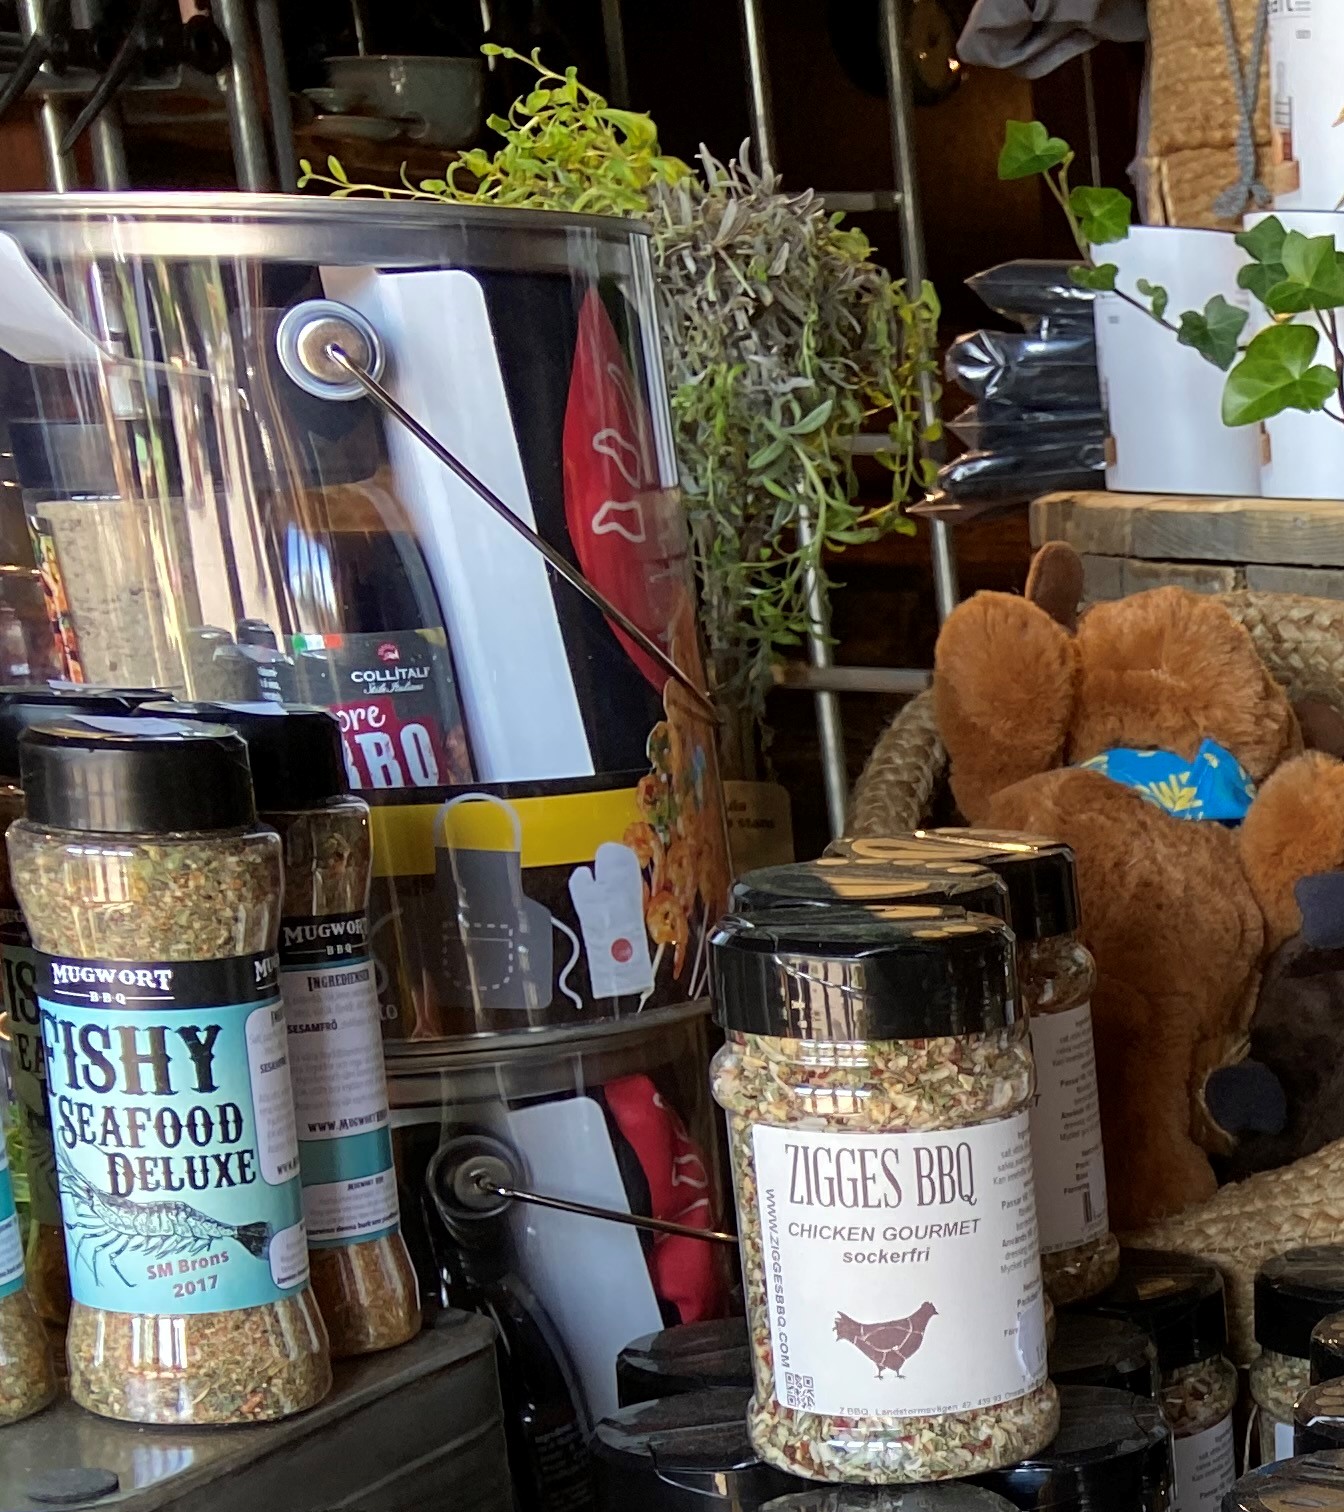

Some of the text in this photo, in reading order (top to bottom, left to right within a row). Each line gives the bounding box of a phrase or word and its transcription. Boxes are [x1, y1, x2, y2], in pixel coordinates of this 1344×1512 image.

[51, 962, 174, 991] MUGWORT
[40, 1010, 224, 1097] FISHY
[57, 1095, 246, 1151] SEAFOOD
[106, 1147, 257, 1199] DELUXE
[784, 1141, 978, 1209] ZIGGES BBQ
[787, 1217, 982, 1243] CHICKEN GOURMET
[146, 1251, 230, 1281] SM Brons
[842, 1246, 931, 1266] sockerfri
[172, 1275, 219, 1299] 2017
